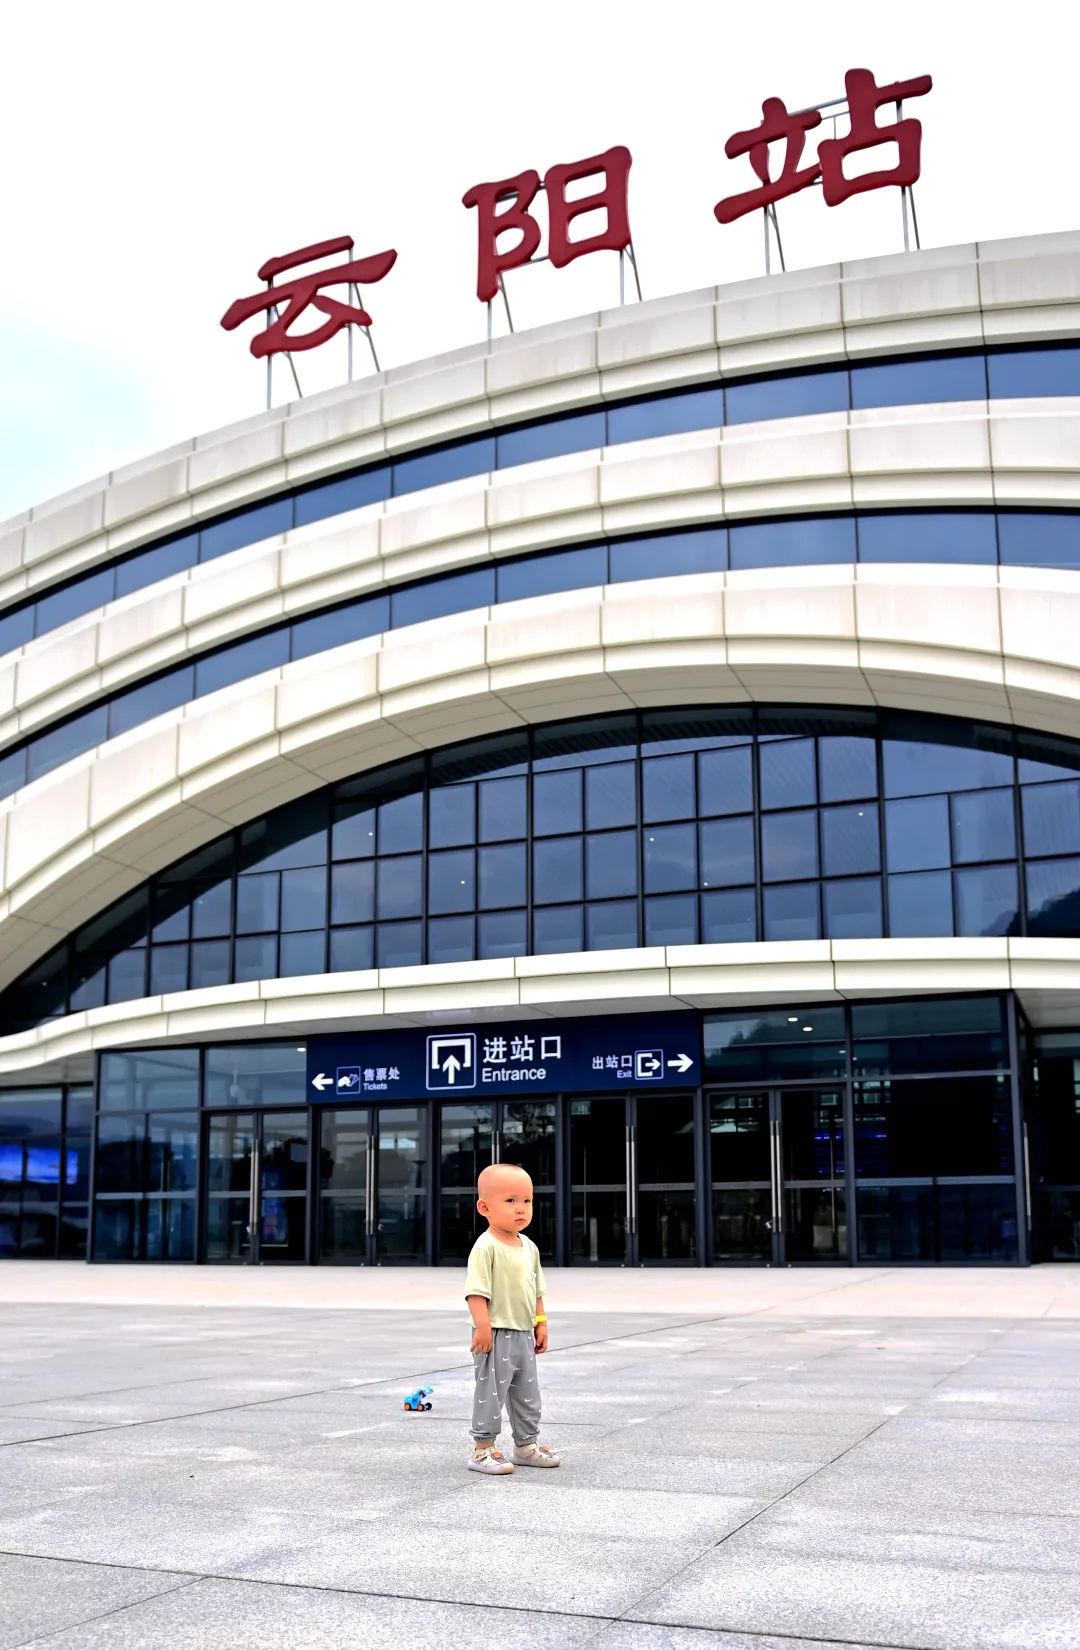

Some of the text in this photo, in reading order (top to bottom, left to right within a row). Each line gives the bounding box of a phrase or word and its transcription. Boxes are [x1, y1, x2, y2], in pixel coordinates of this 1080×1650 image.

[221, 68, 932, 358] 云阳站
[482, 1035, 562, 1063] 进站口
[591, 1054, 633, 1070] 出站口
[362, 1067, 400, 1082] 售票处
[481, 1067, 547, 1083] Entrance
[616, 1069, 632, 1079] Exit
[362, 1082, 388, 1091] Tickets
